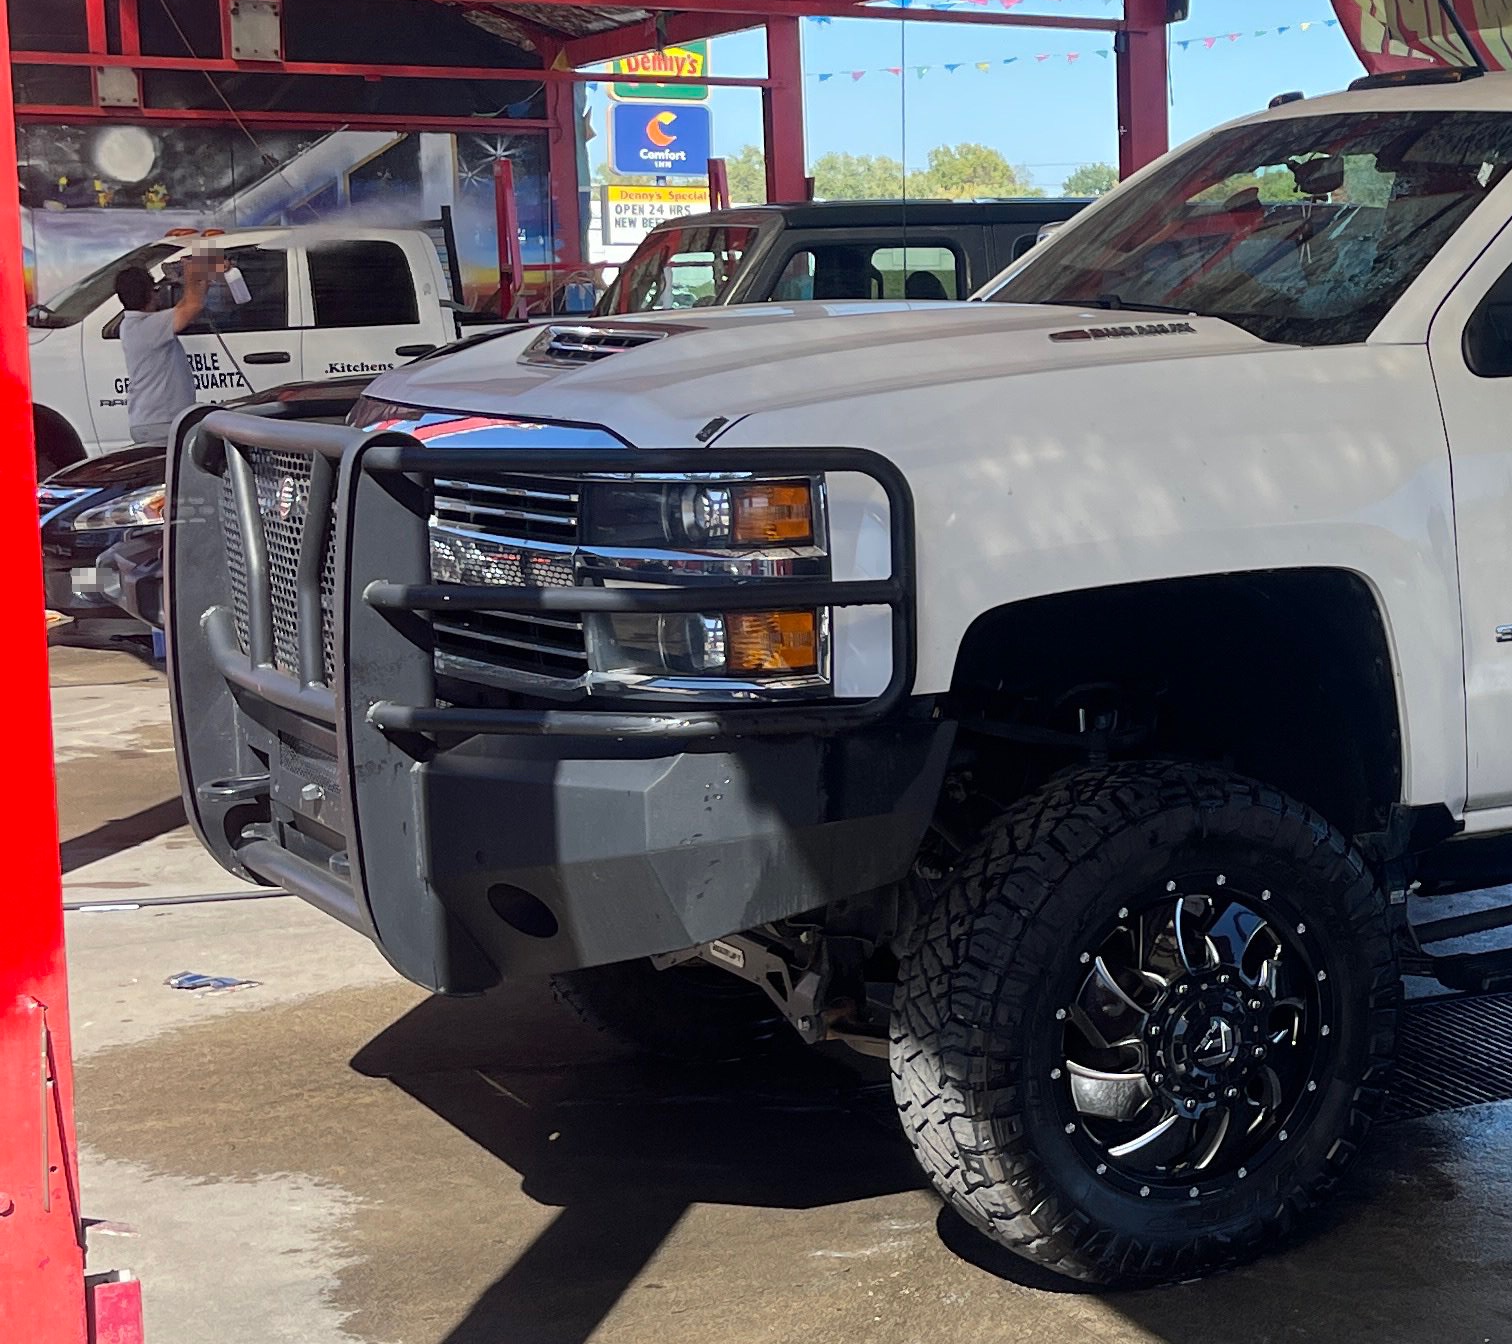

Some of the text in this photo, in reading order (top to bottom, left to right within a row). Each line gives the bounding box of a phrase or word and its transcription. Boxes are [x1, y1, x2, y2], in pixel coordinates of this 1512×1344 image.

[626, 51, 698, 77] Denny's
[639, 148, 687, 161] Comfort
[620, 190, 707, 203] Denny's Special
[614, 204, 691, 216] OPEN 24 HRS
[614, 217, 638, 228] NEW
[186, 352, 220, 372] RBLE
